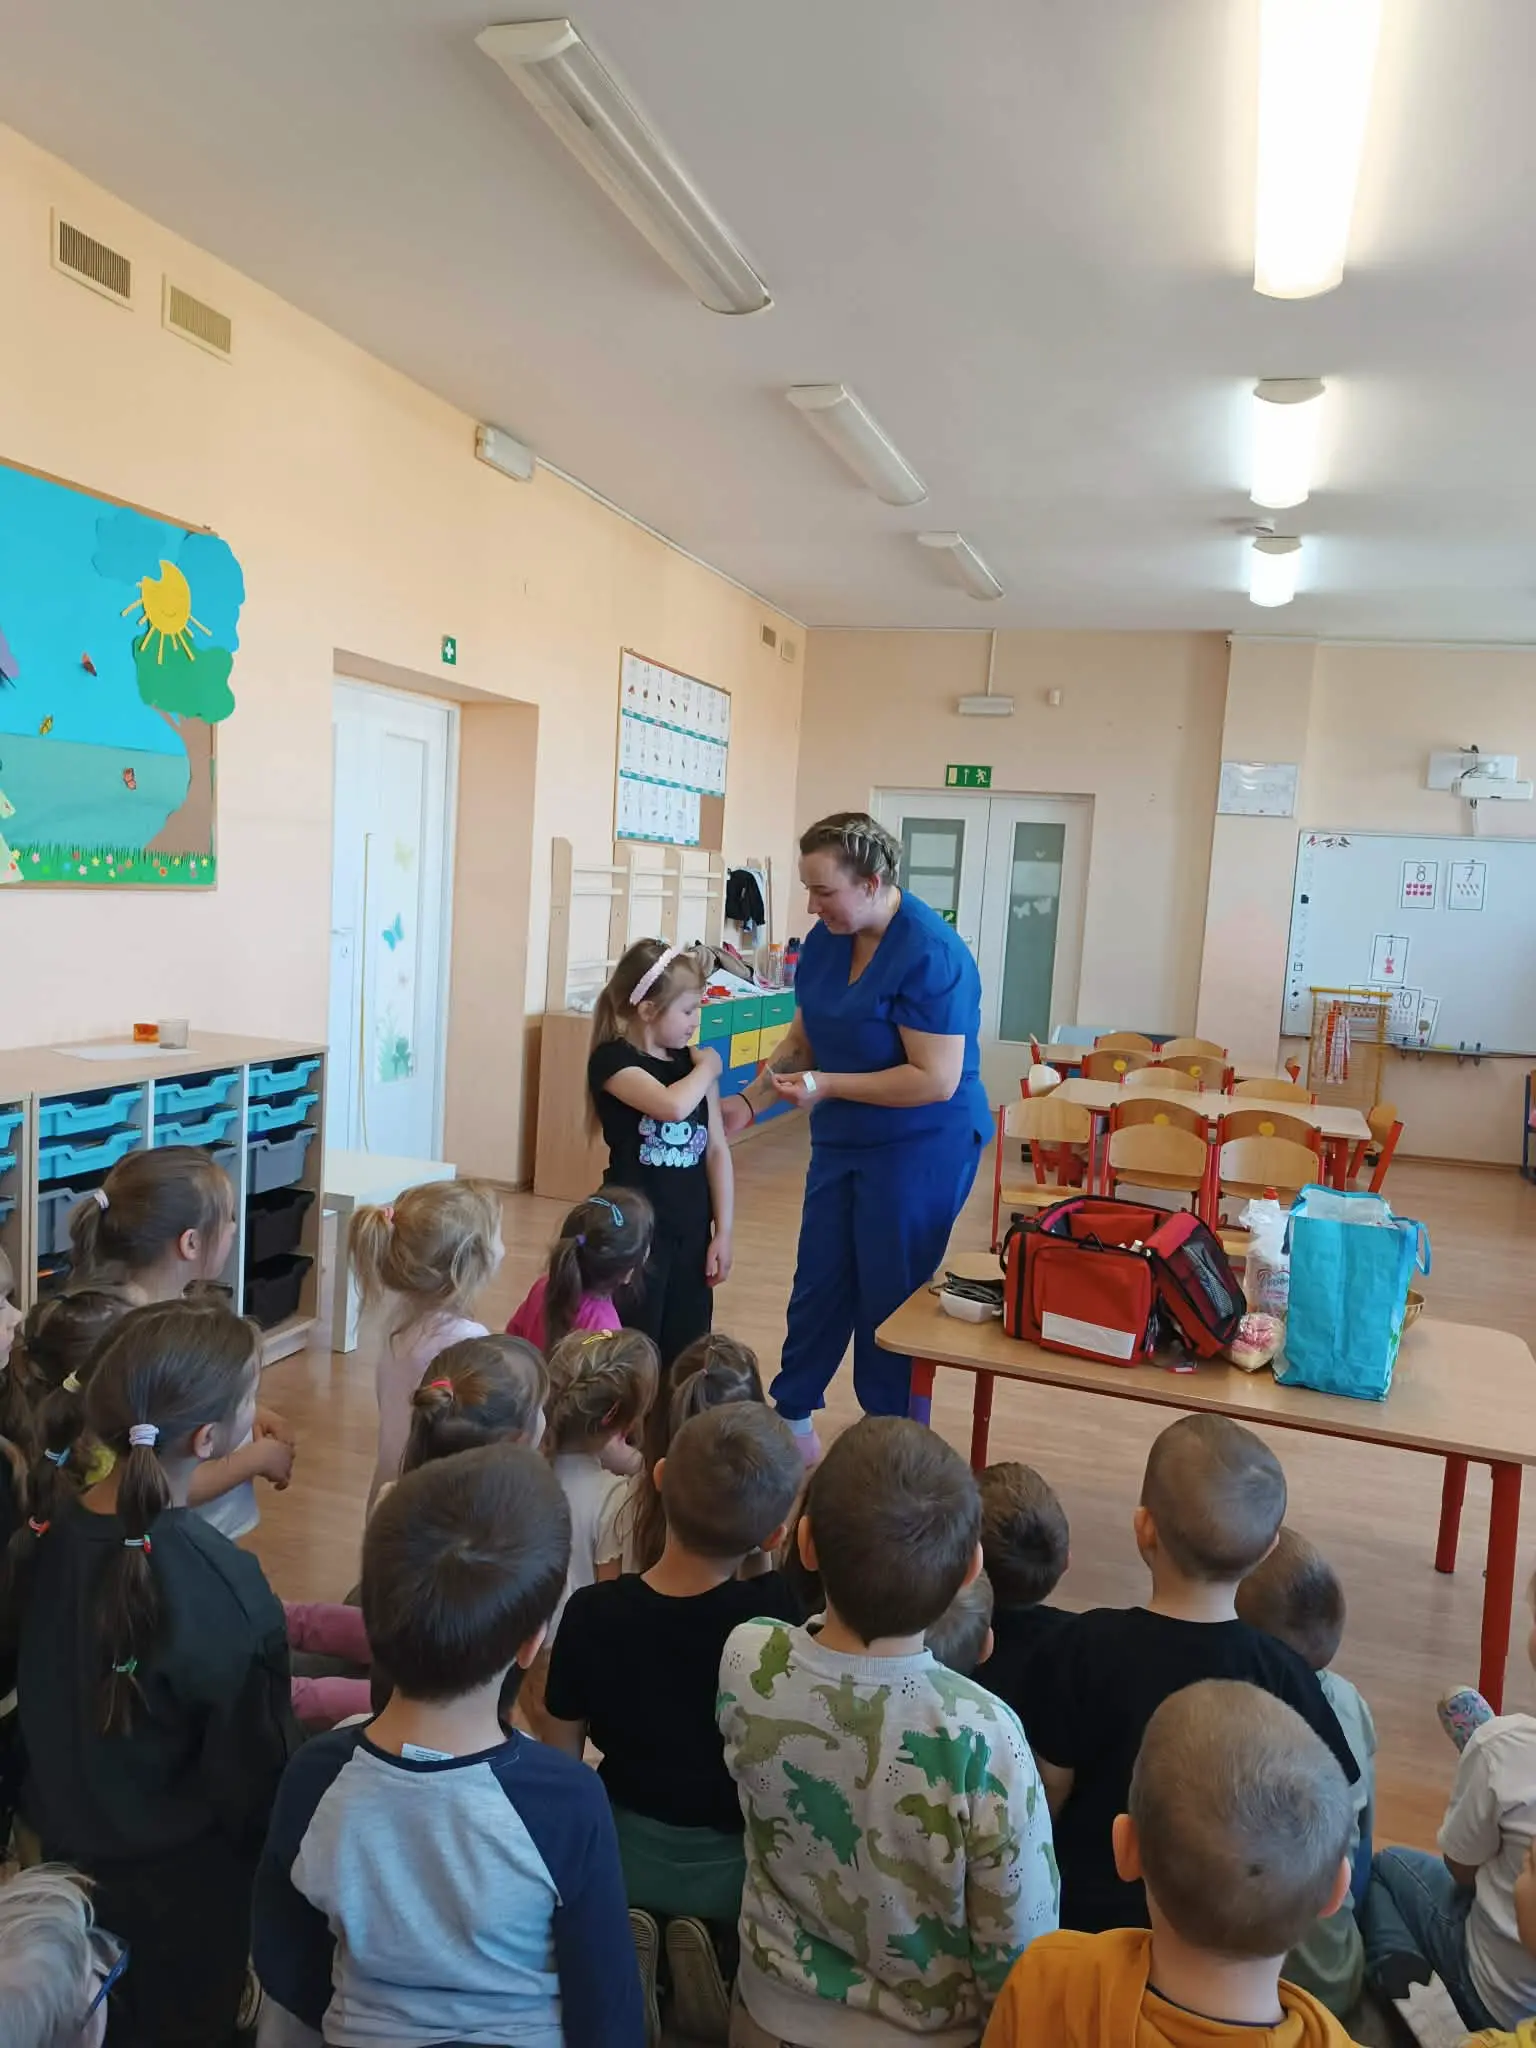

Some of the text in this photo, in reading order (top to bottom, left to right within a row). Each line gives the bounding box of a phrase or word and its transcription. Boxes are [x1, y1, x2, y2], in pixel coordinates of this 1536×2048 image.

[1416, 865, 1427, 882] 8
[1464, 866, 1475, 882] 7
[1397, 991, 1413, 1010] 10
